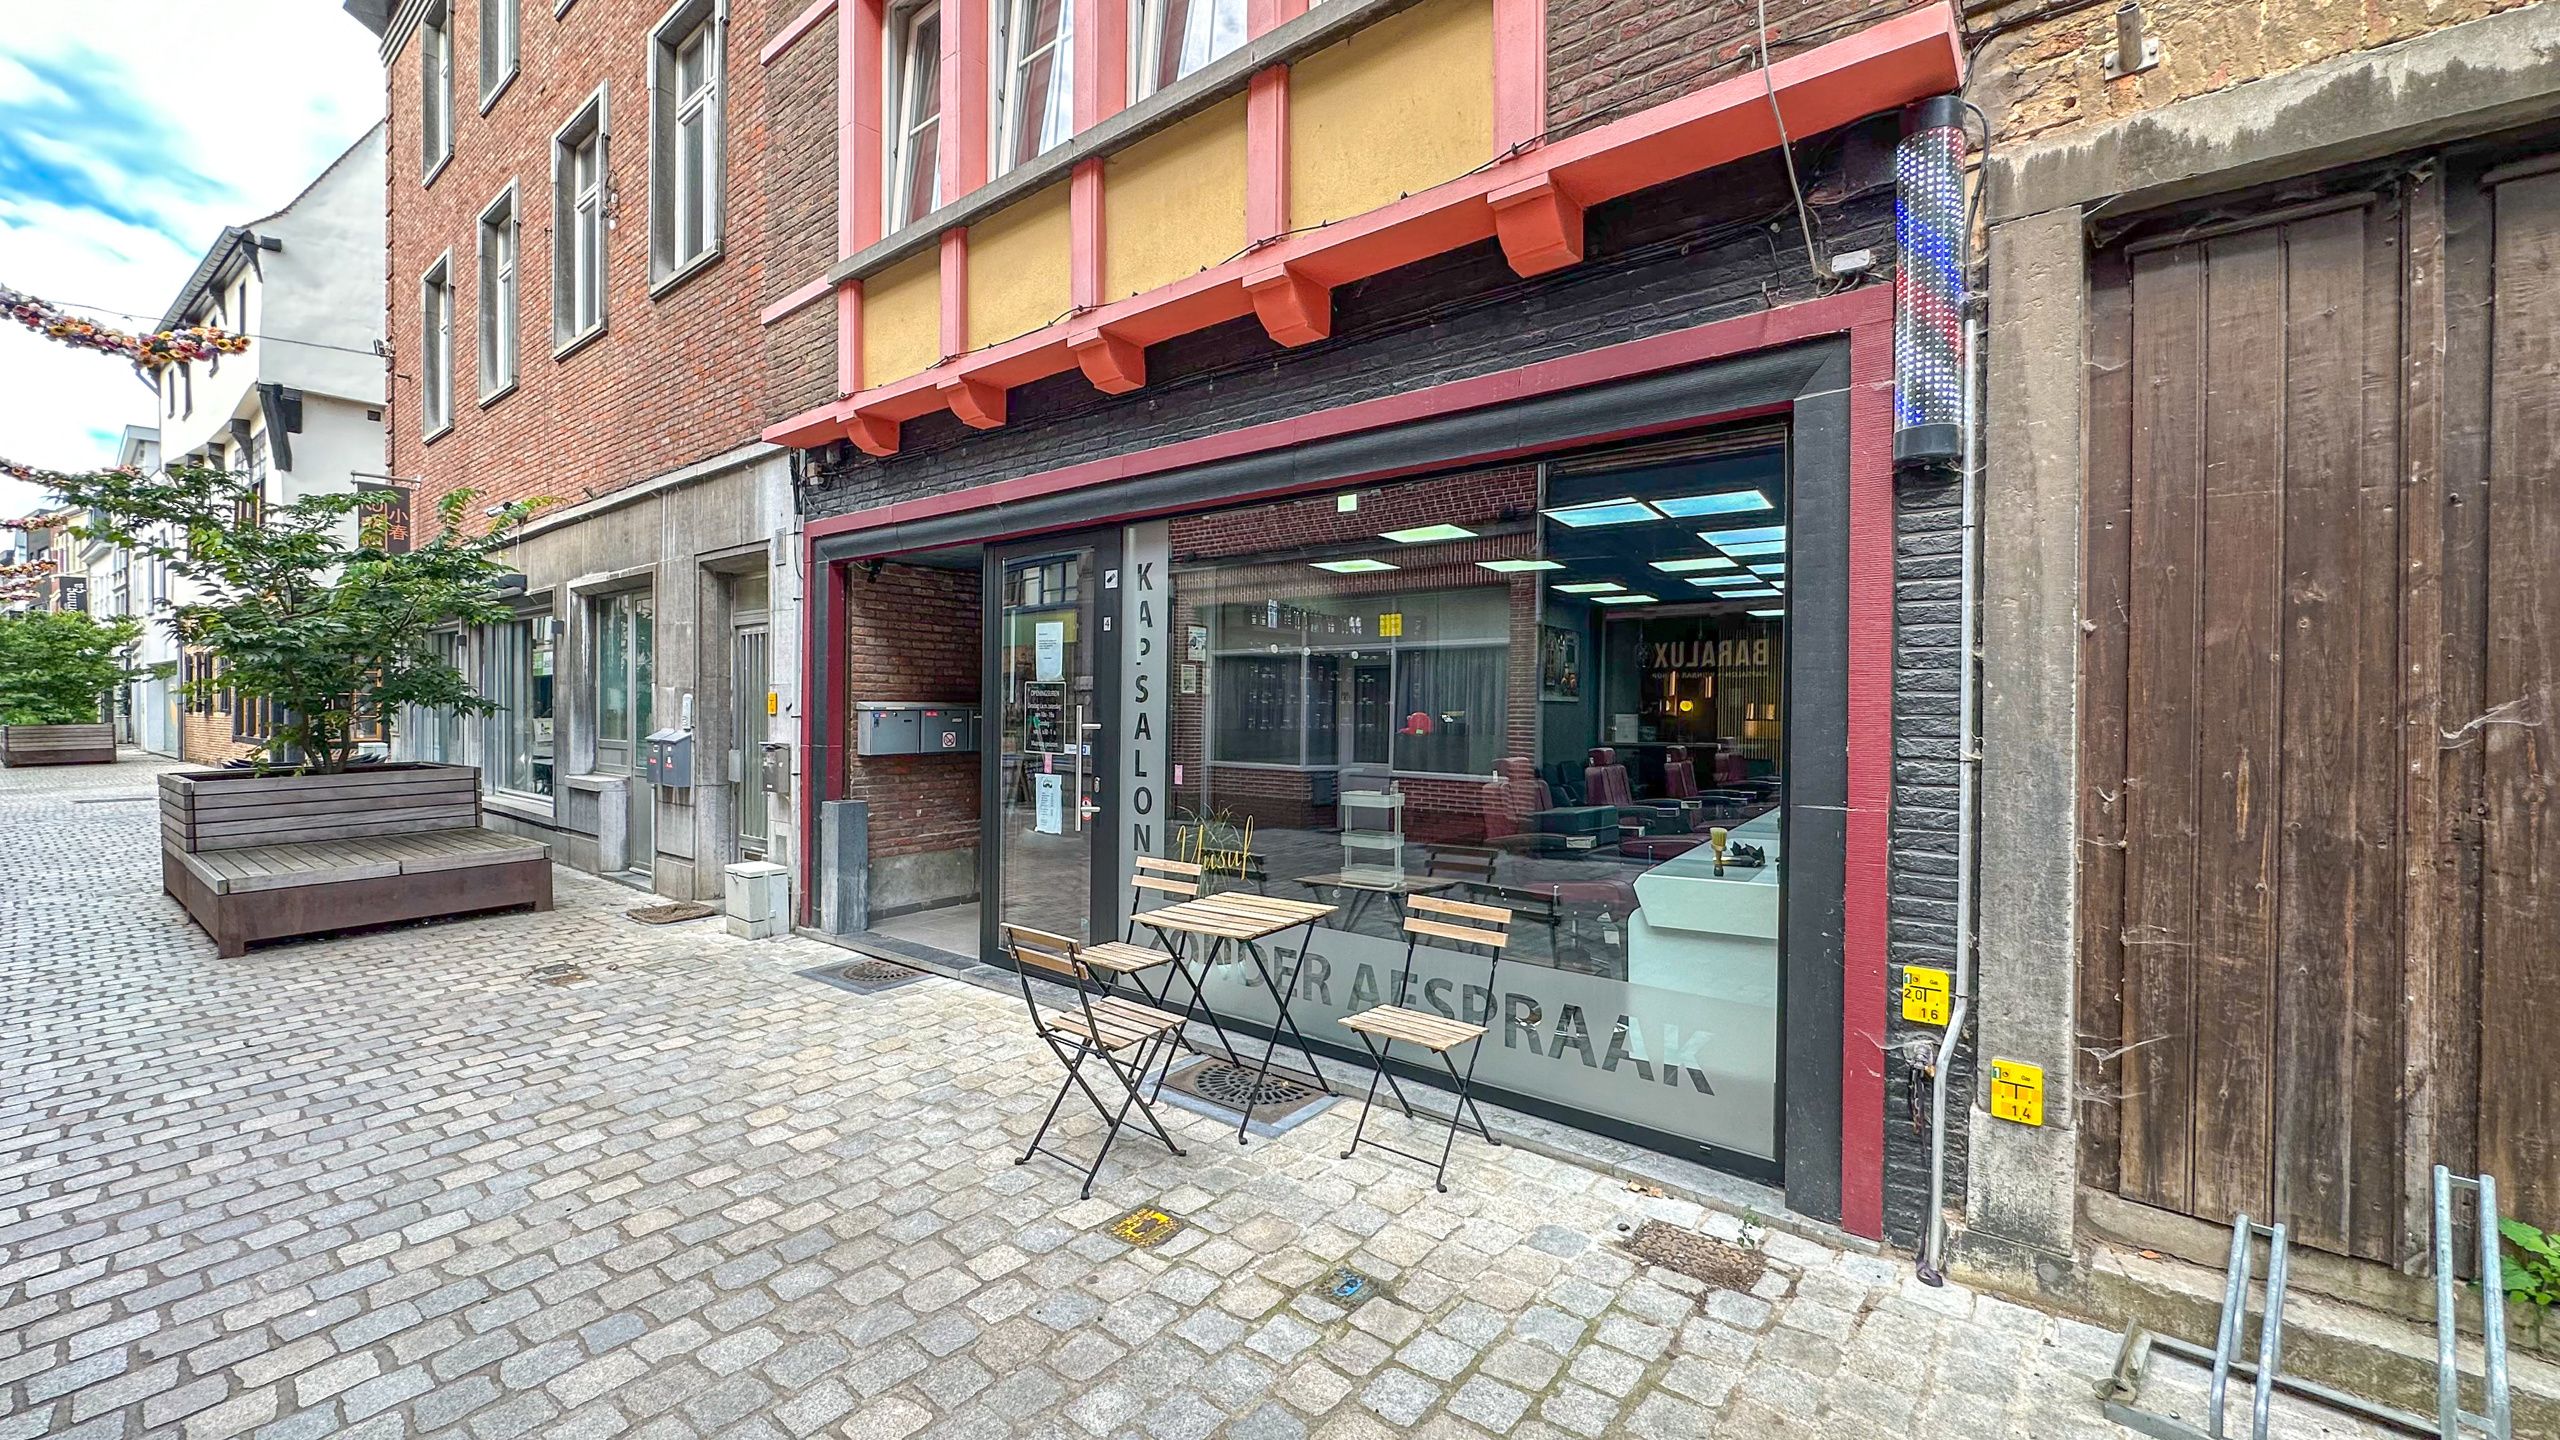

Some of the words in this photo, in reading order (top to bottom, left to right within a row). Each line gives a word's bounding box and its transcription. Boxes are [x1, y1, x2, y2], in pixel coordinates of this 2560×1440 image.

[387, 508, 409, 540] 小春
[1133, 562, 1154, 853] KAPSALON
[1347, 962, 1715, 1096] AFSPRAAK
